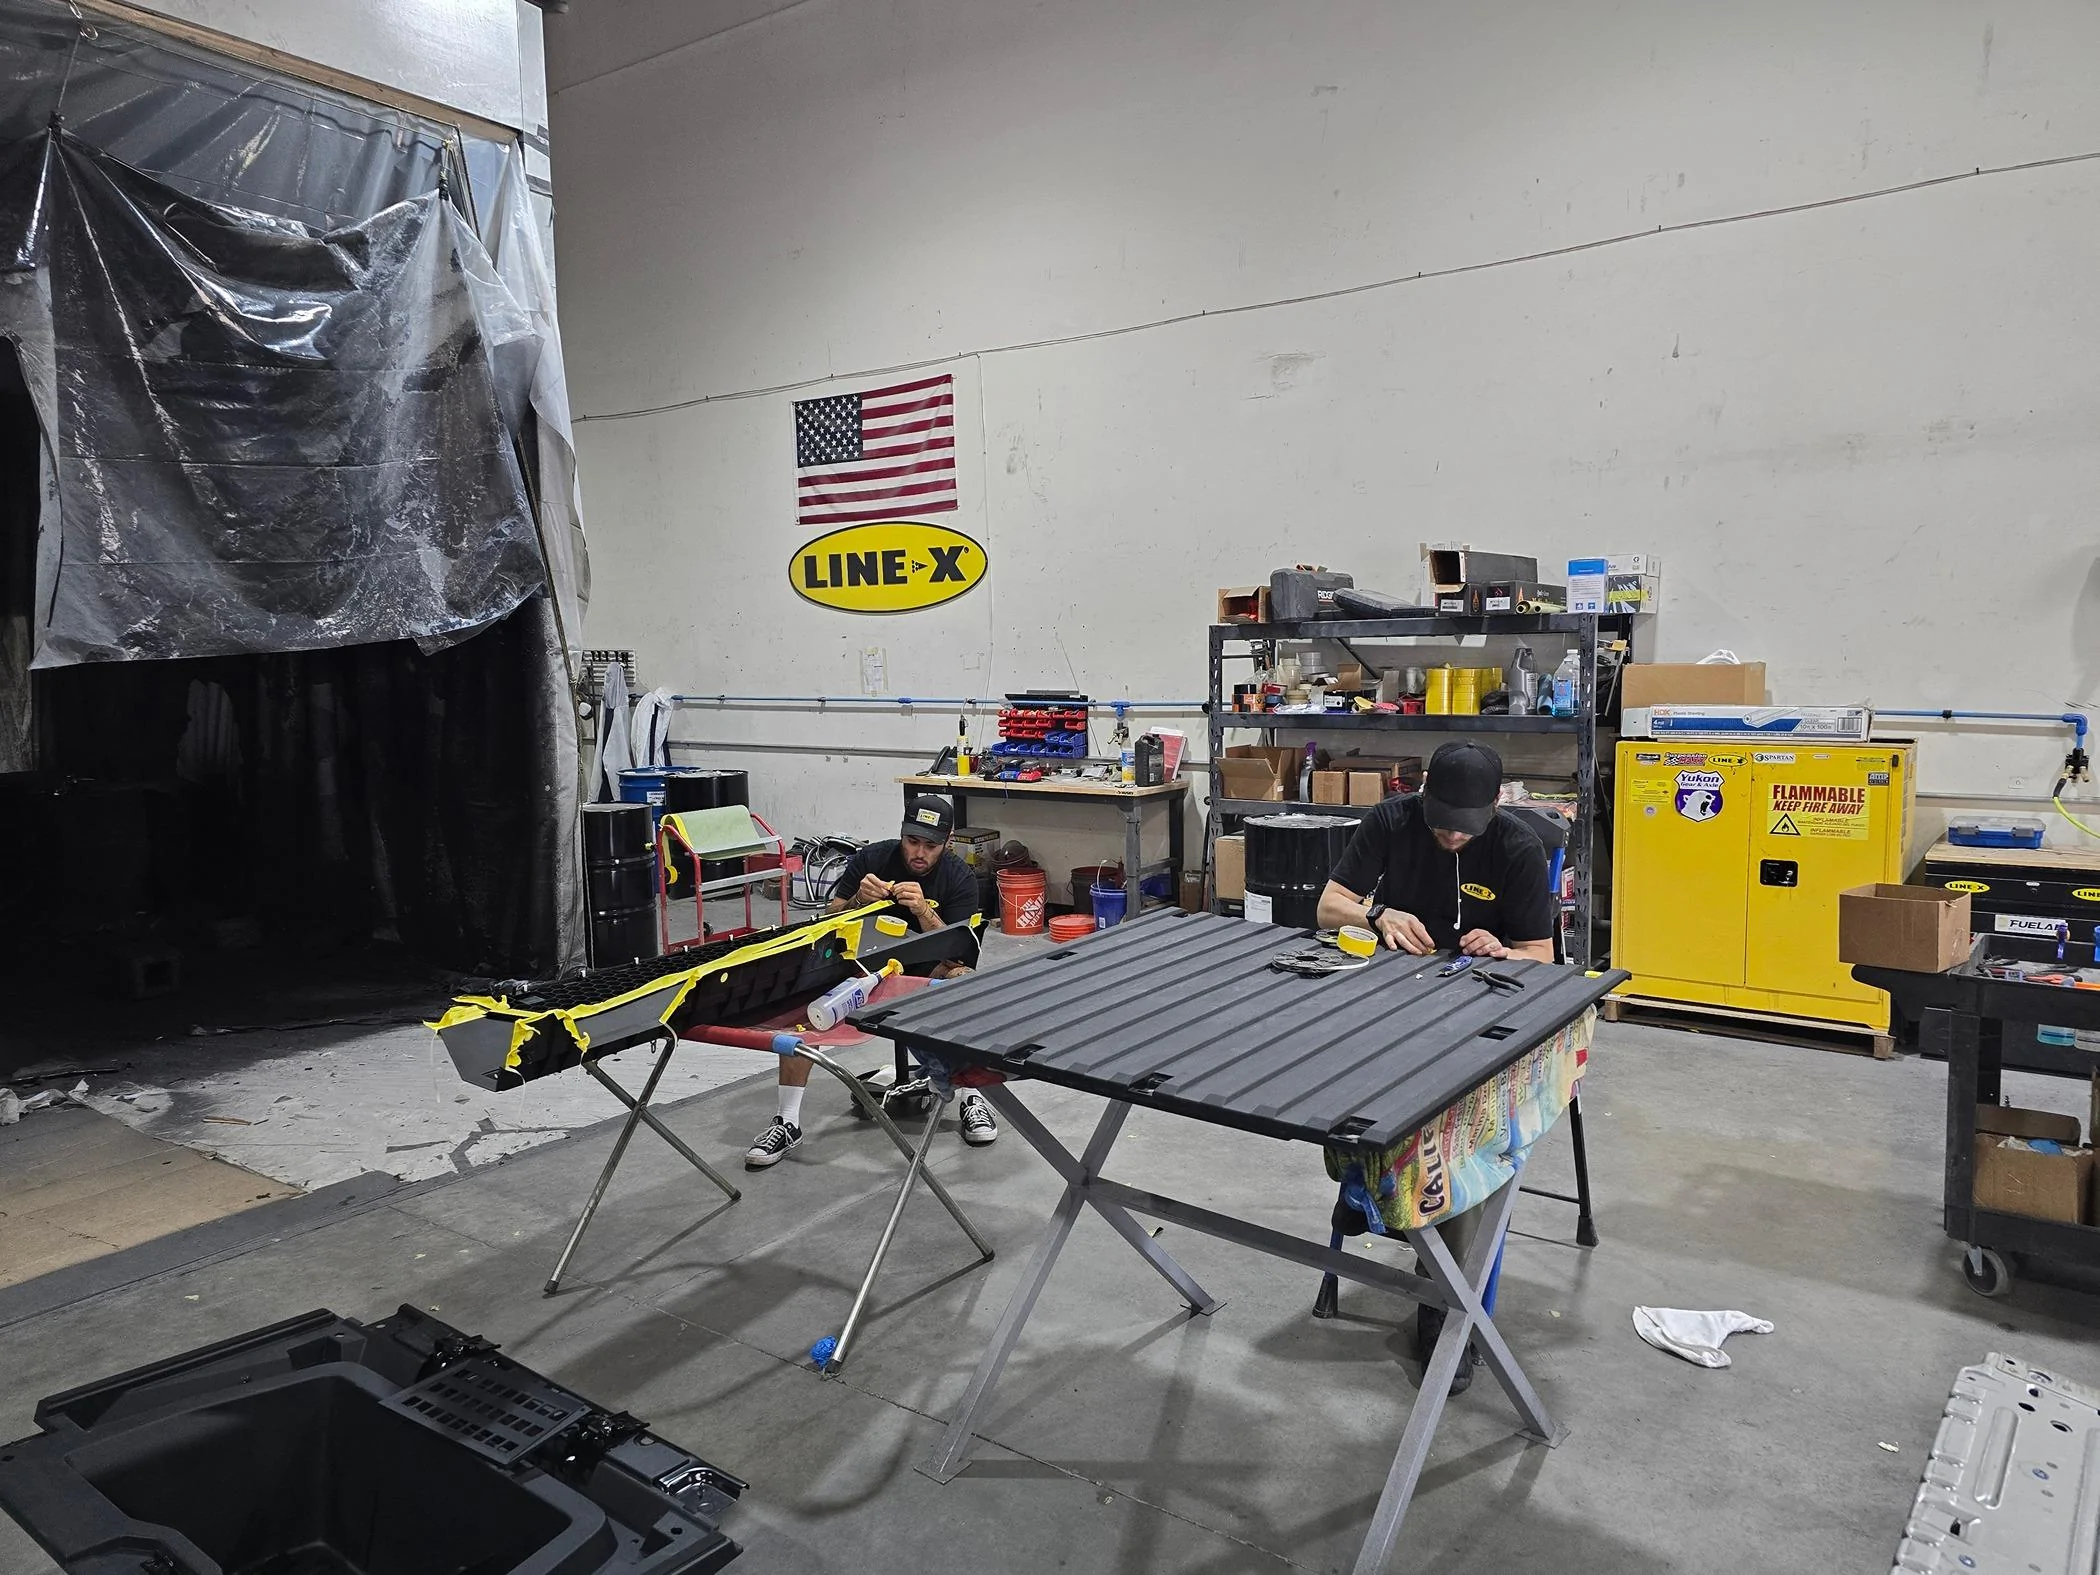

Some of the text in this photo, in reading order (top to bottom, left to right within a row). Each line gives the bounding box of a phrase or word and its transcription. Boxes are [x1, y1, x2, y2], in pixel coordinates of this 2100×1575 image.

[1764, 753, 1794, 762] SPARTAN
[1681, 773, 1720, 783] Yukon
[1773, 784, 1866, 804] FLAMMABLE
[1773, 800, 1865, 815] KEEP FIRE AWAY
[1499, 1090, 1507, 1138] Venice
[1467, 1108, 1487, 1150] Marina
